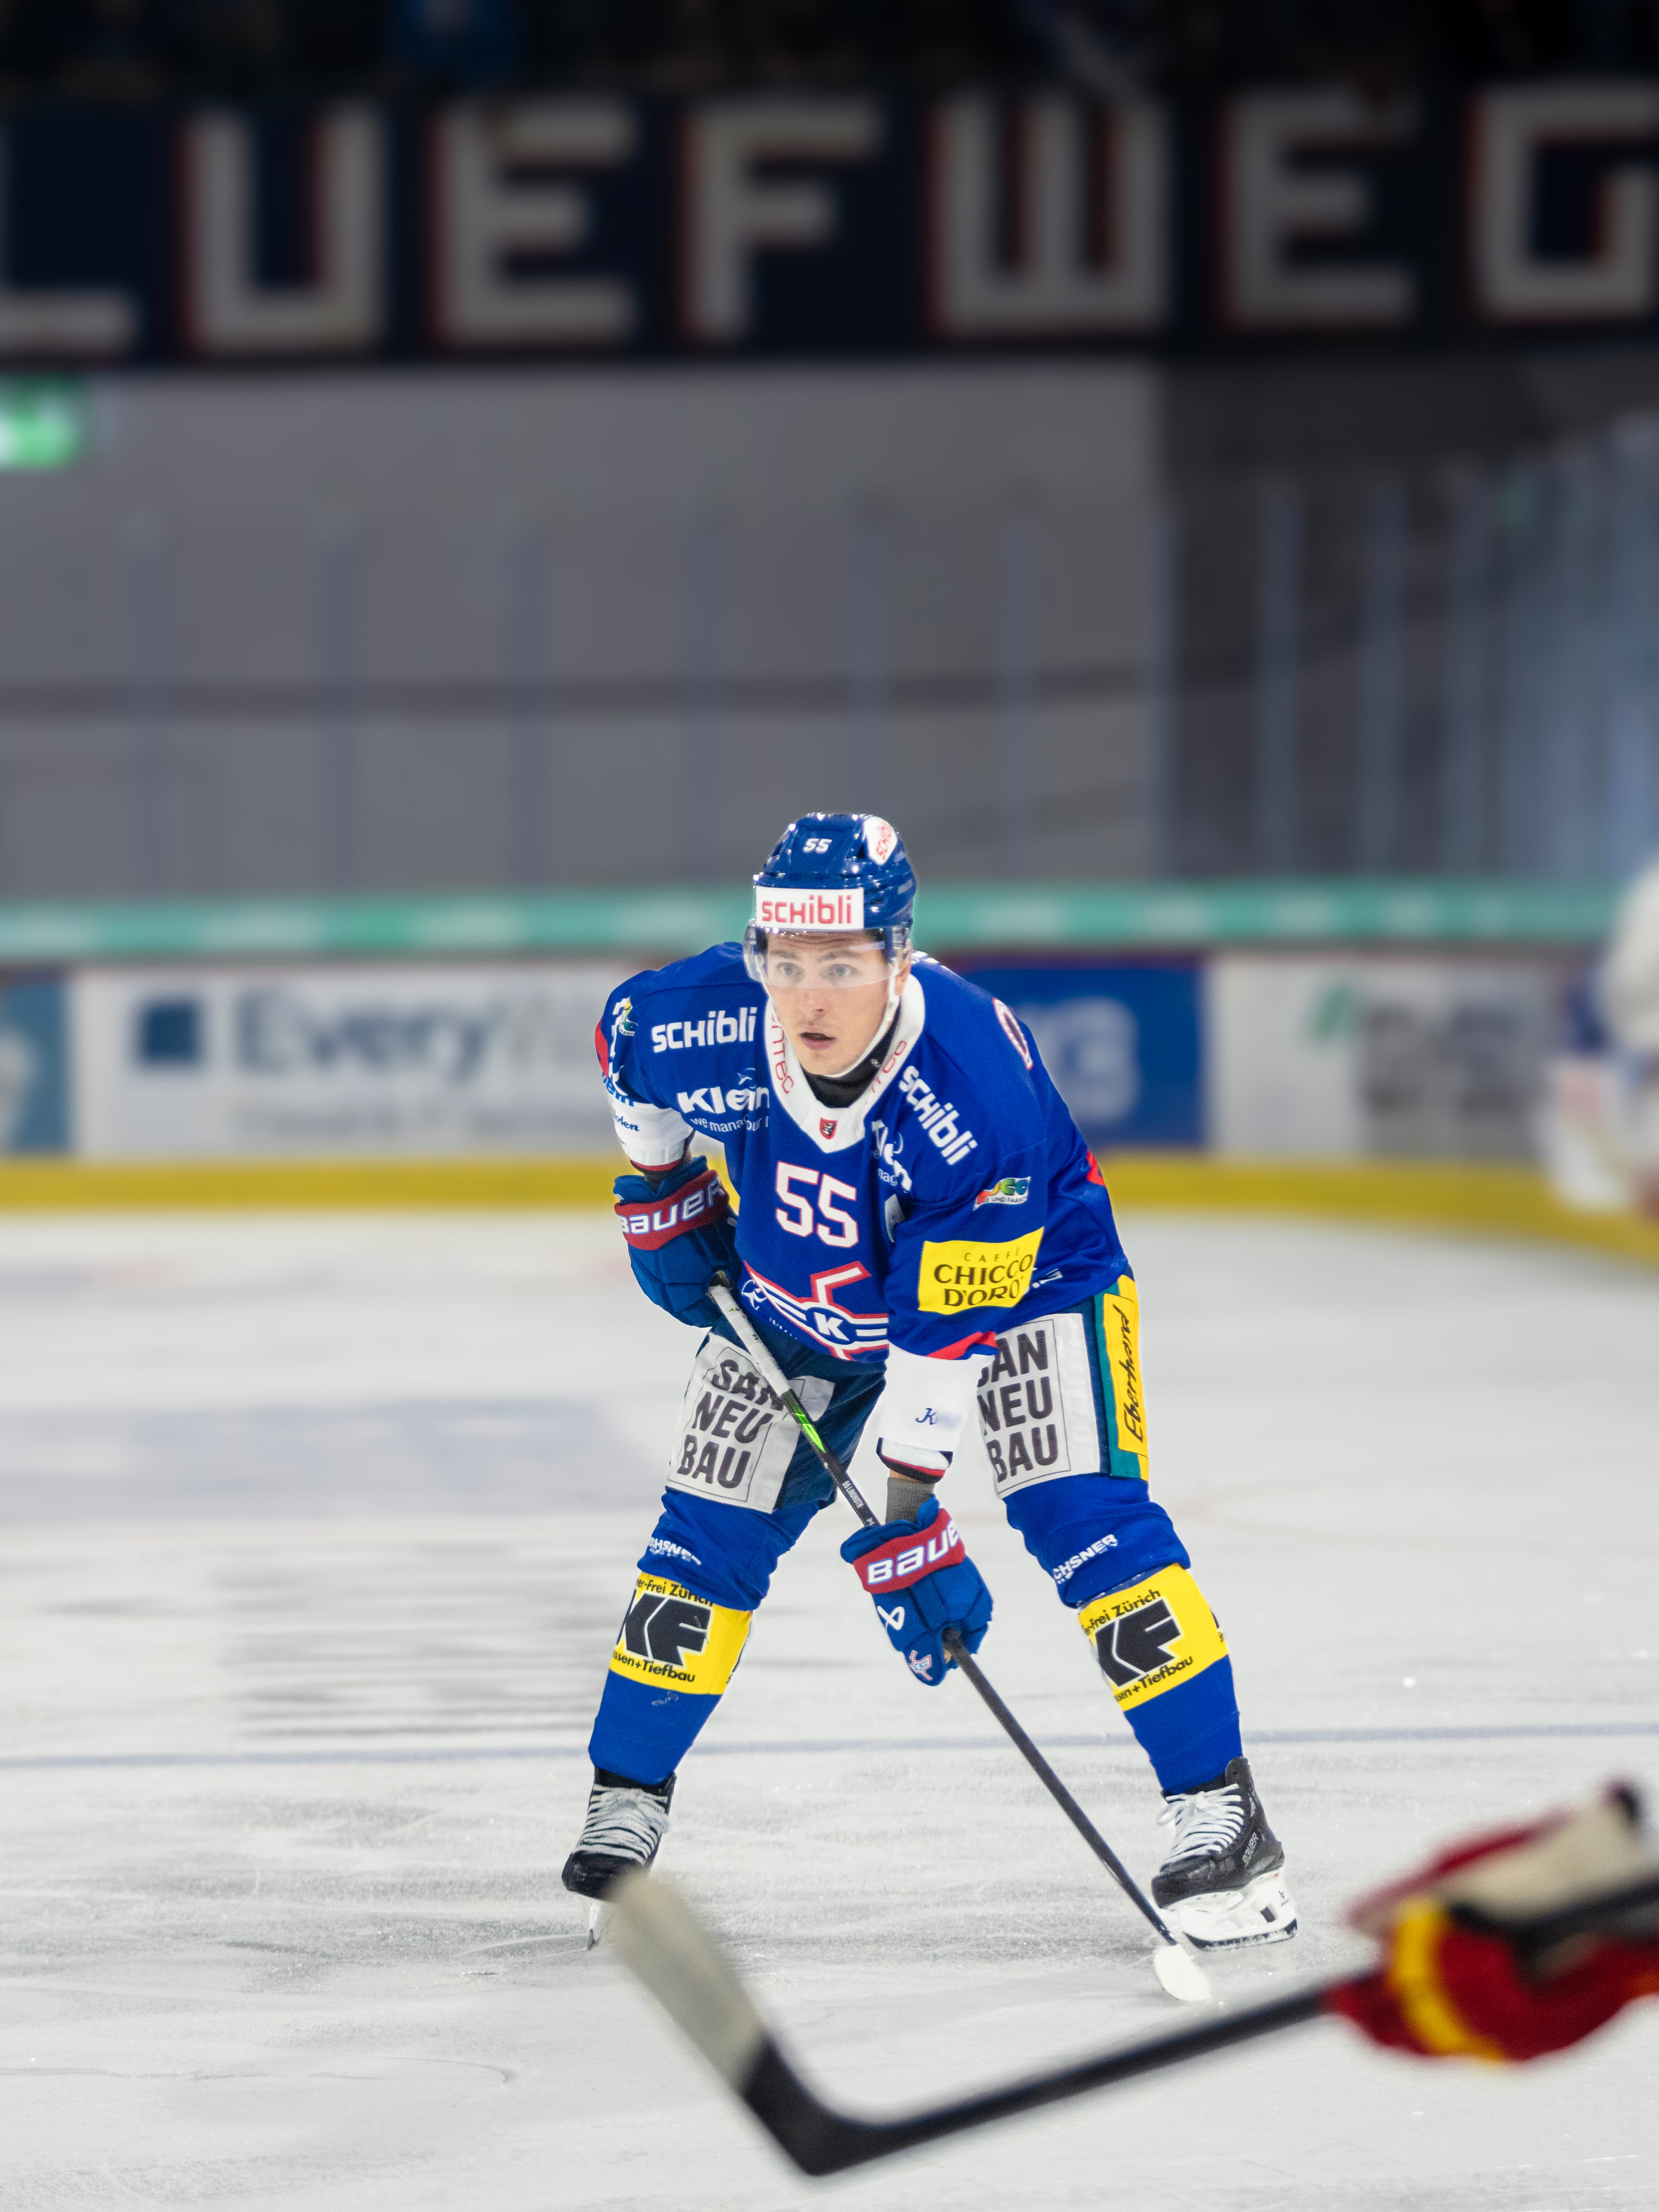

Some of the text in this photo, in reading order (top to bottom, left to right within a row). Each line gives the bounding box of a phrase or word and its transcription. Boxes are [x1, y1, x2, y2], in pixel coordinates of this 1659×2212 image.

[803, 838, 832, 853] 55
[776, 1160, 859, 1249] 55
[934, 1254, 1033, 1285] CHICCO
[964, 1247, 1020, 1263] CAFFÈ
[944, 1279, 1020, 1307] D'ORO
[692, 1391, 774, 1444] NEU
[977, 1376, 1053, 1436] NEU
[677, 1434, 751, 1489] BAU
[986, 1424, 1059, 1483] BAU
[867, 1518, 960, 1585] BAUE
[1053, 1534, 1118, 1580] CHSNER
[1111, 1589, 1161, 1618] Zürich
